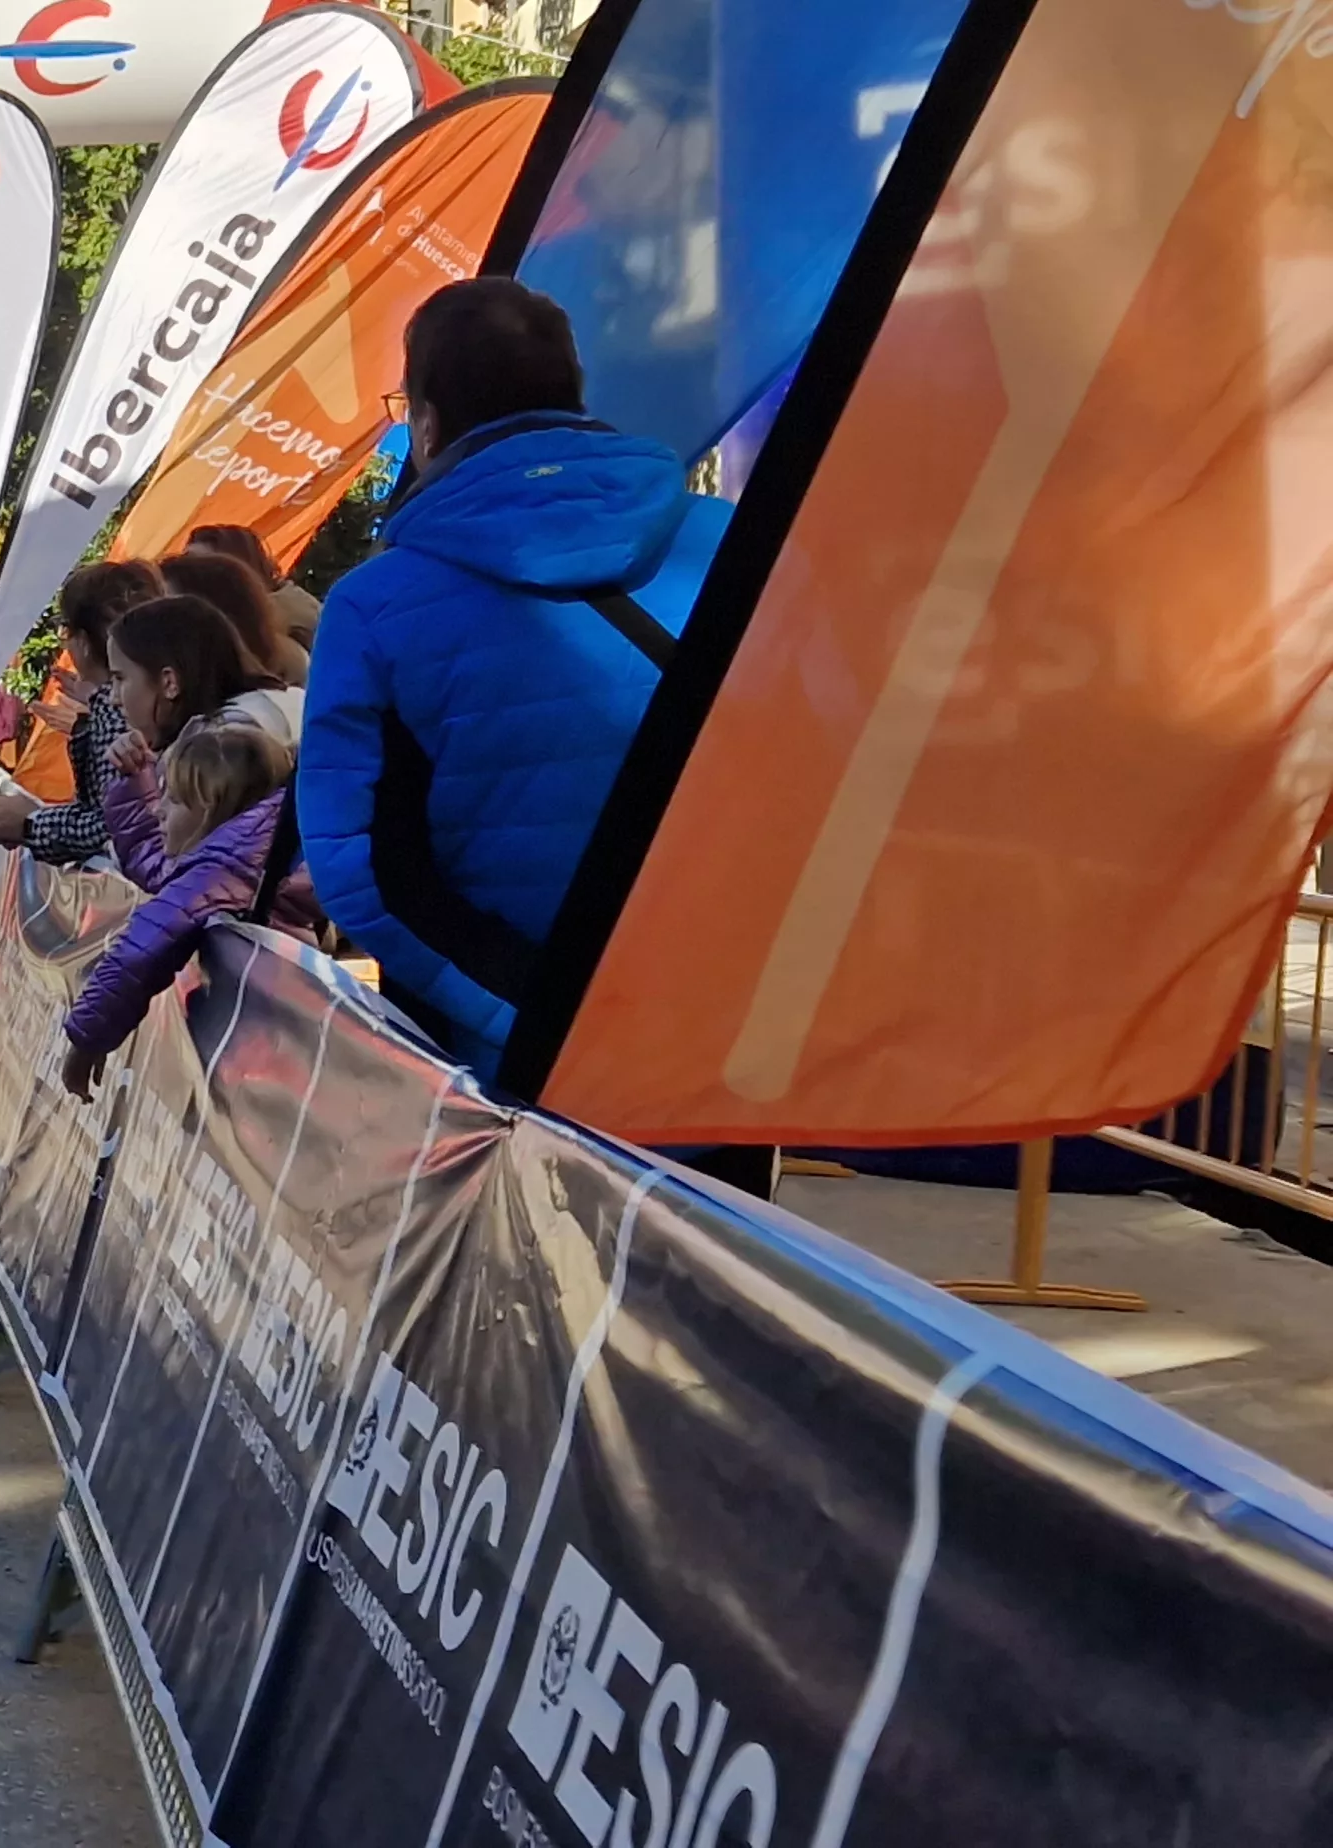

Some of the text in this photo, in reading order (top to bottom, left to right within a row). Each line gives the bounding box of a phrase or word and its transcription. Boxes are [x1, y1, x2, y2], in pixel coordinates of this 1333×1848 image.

[49, 213, 277, 510] Ibercaja
[411, 234, 465, 281] Huesca
[256, 1255, 347, 1452] ESIC
[361, 1381, 508, 1651] ESIC
